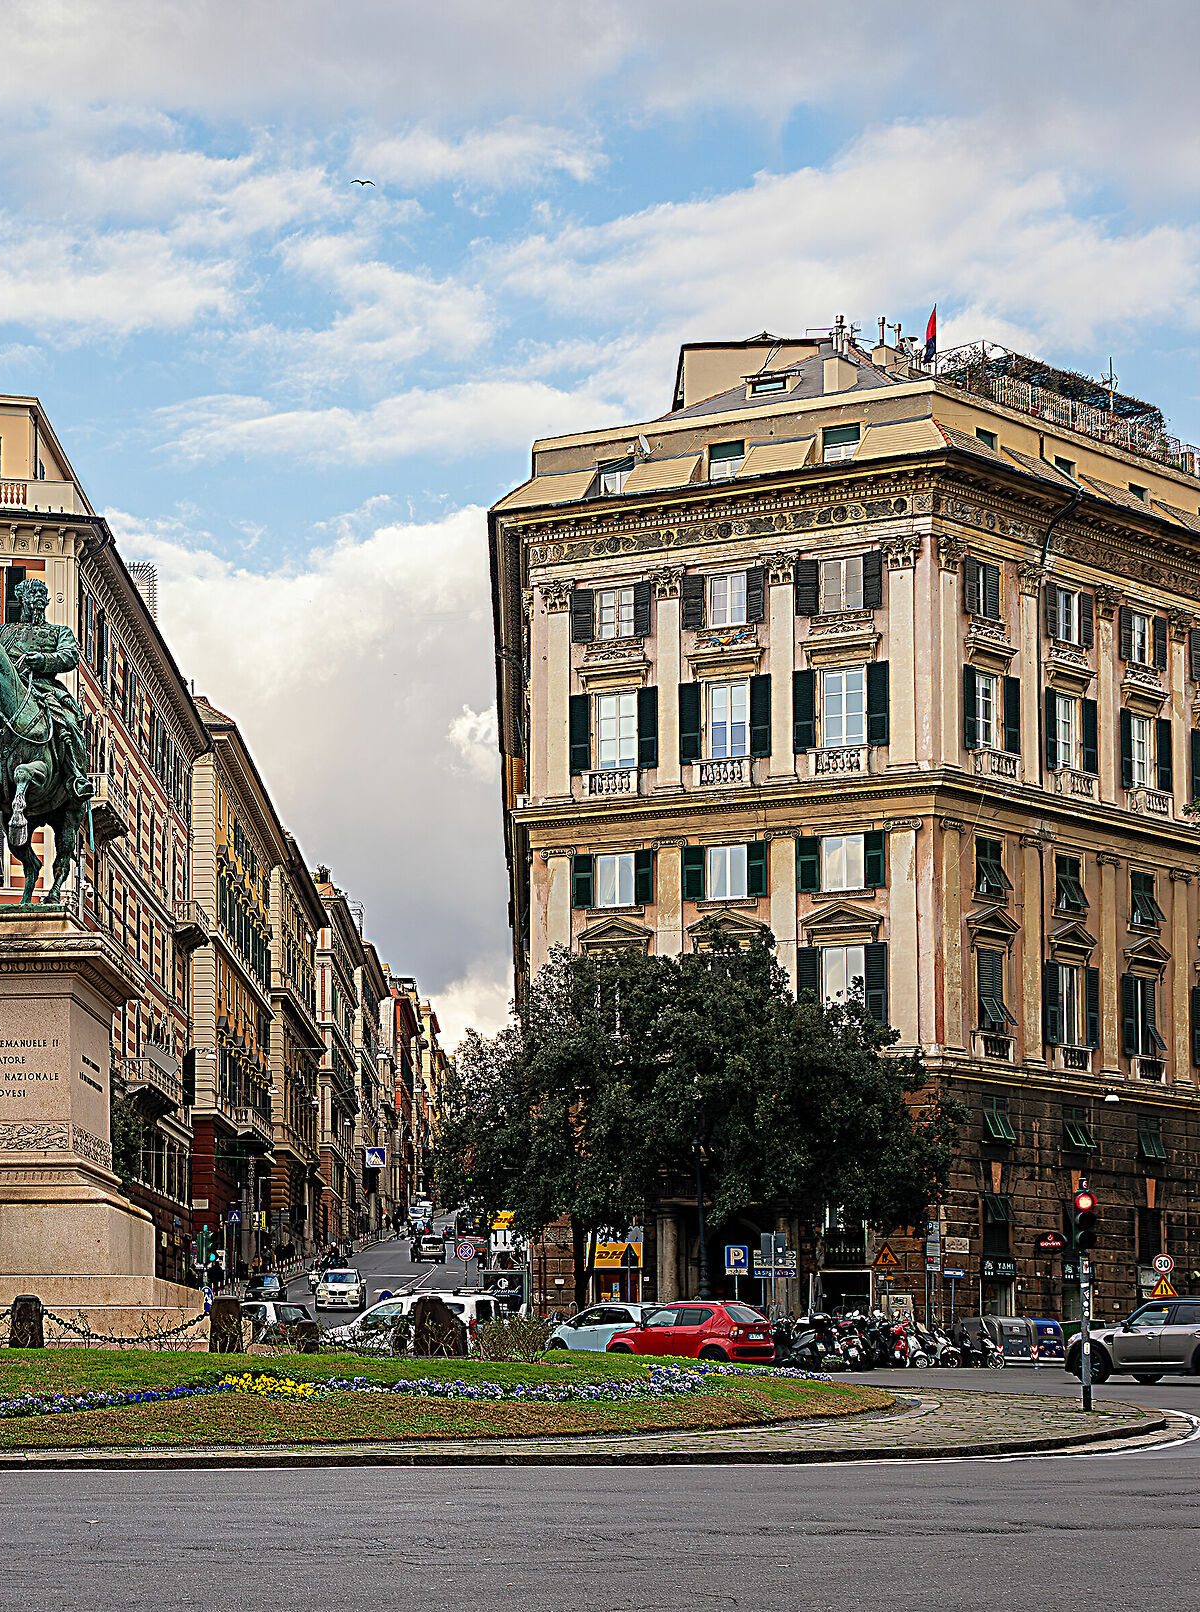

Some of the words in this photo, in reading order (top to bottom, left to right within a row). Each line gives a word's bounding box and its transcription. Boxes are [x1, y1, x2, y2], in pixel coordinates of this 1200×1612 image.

[0, 1039, 47, 1048] EMANUELE
[52, 1039, 59, 1048] II
[4, 1072, 59, 1081] NAZIONALE
[596, 1250, 625, 1260] DH
[730, 1247, 744, 1266] P
[1157, 1259, 1170, 1269] 30
